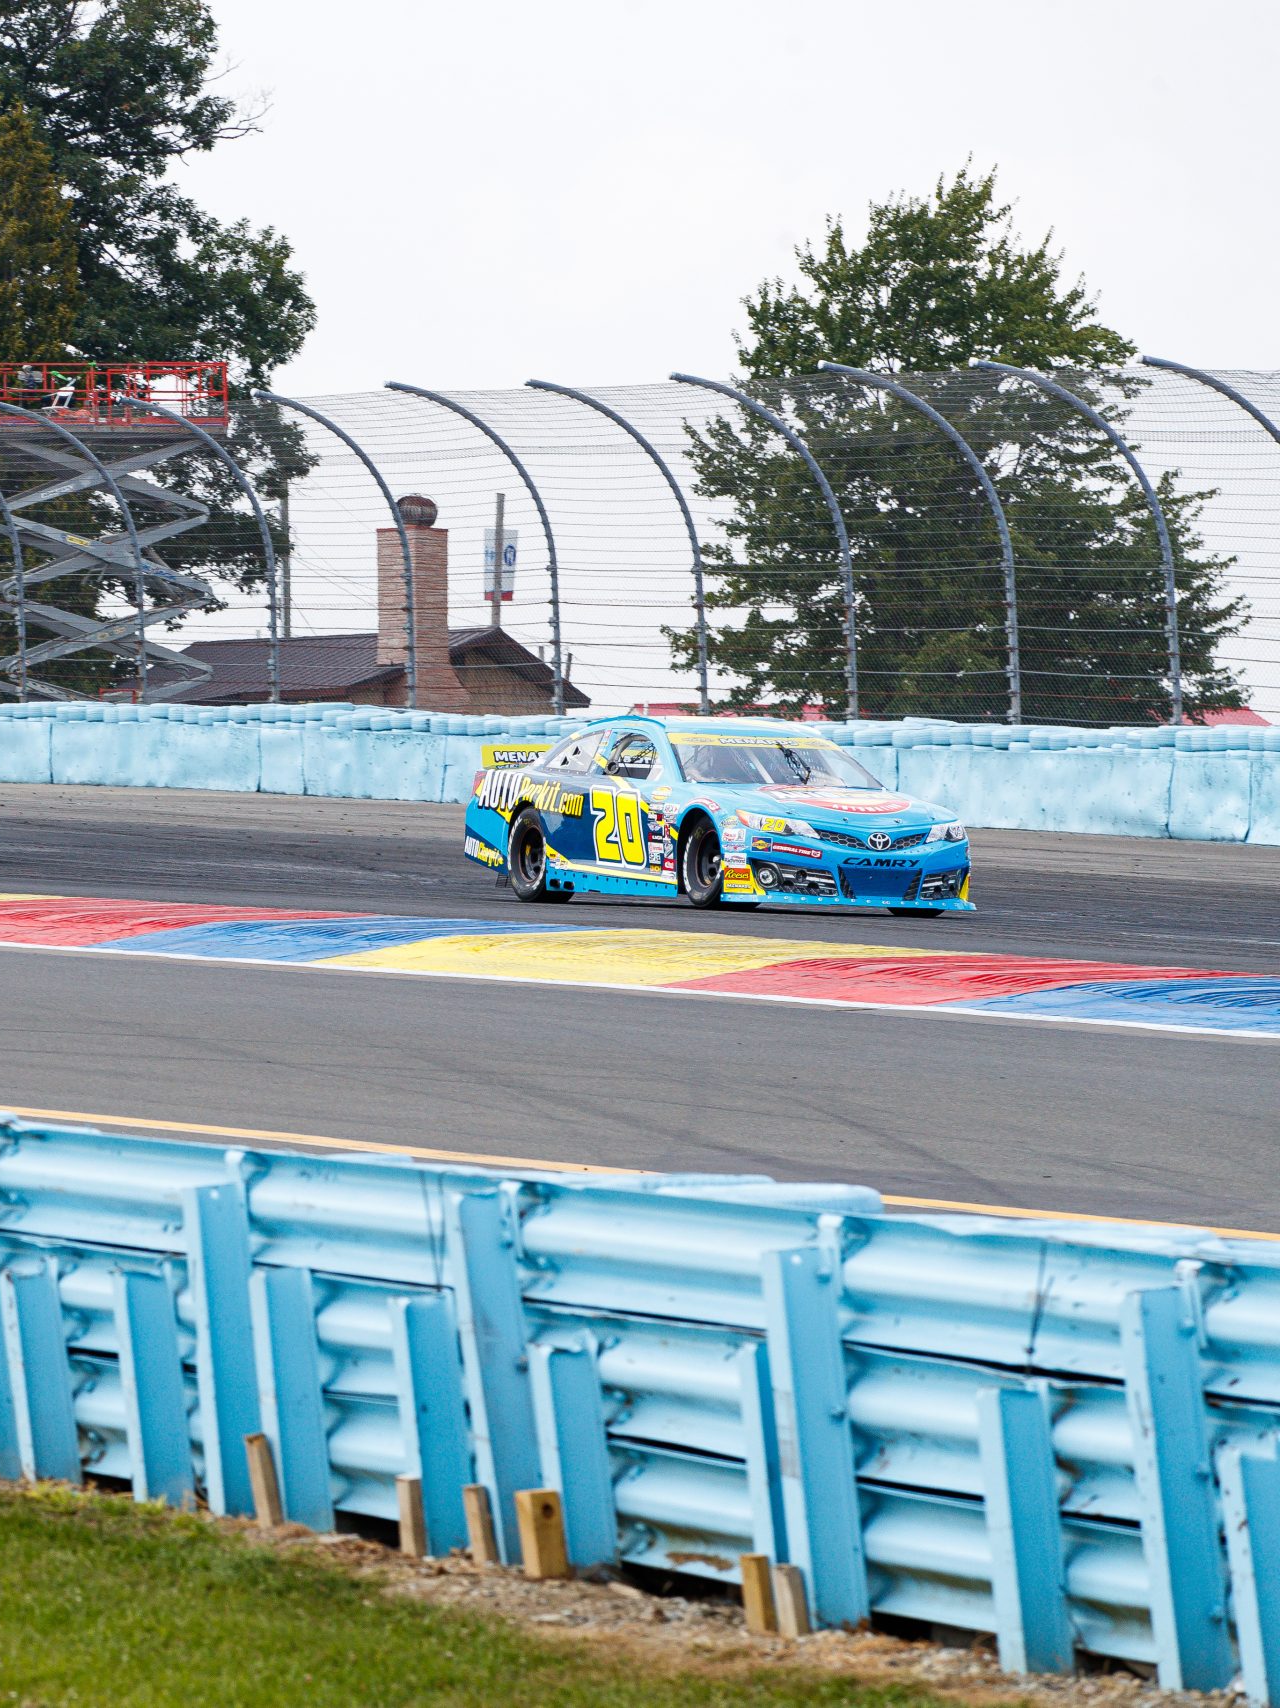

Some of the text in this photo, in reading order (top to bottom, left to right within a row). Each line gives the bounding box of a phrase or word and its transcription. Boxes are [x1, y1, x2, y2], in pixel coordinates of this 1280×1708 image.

[589, 784, 648, 870] 20
[761, 817, 786, 833] 20
[842, 857, 919, 868] CAMRY
